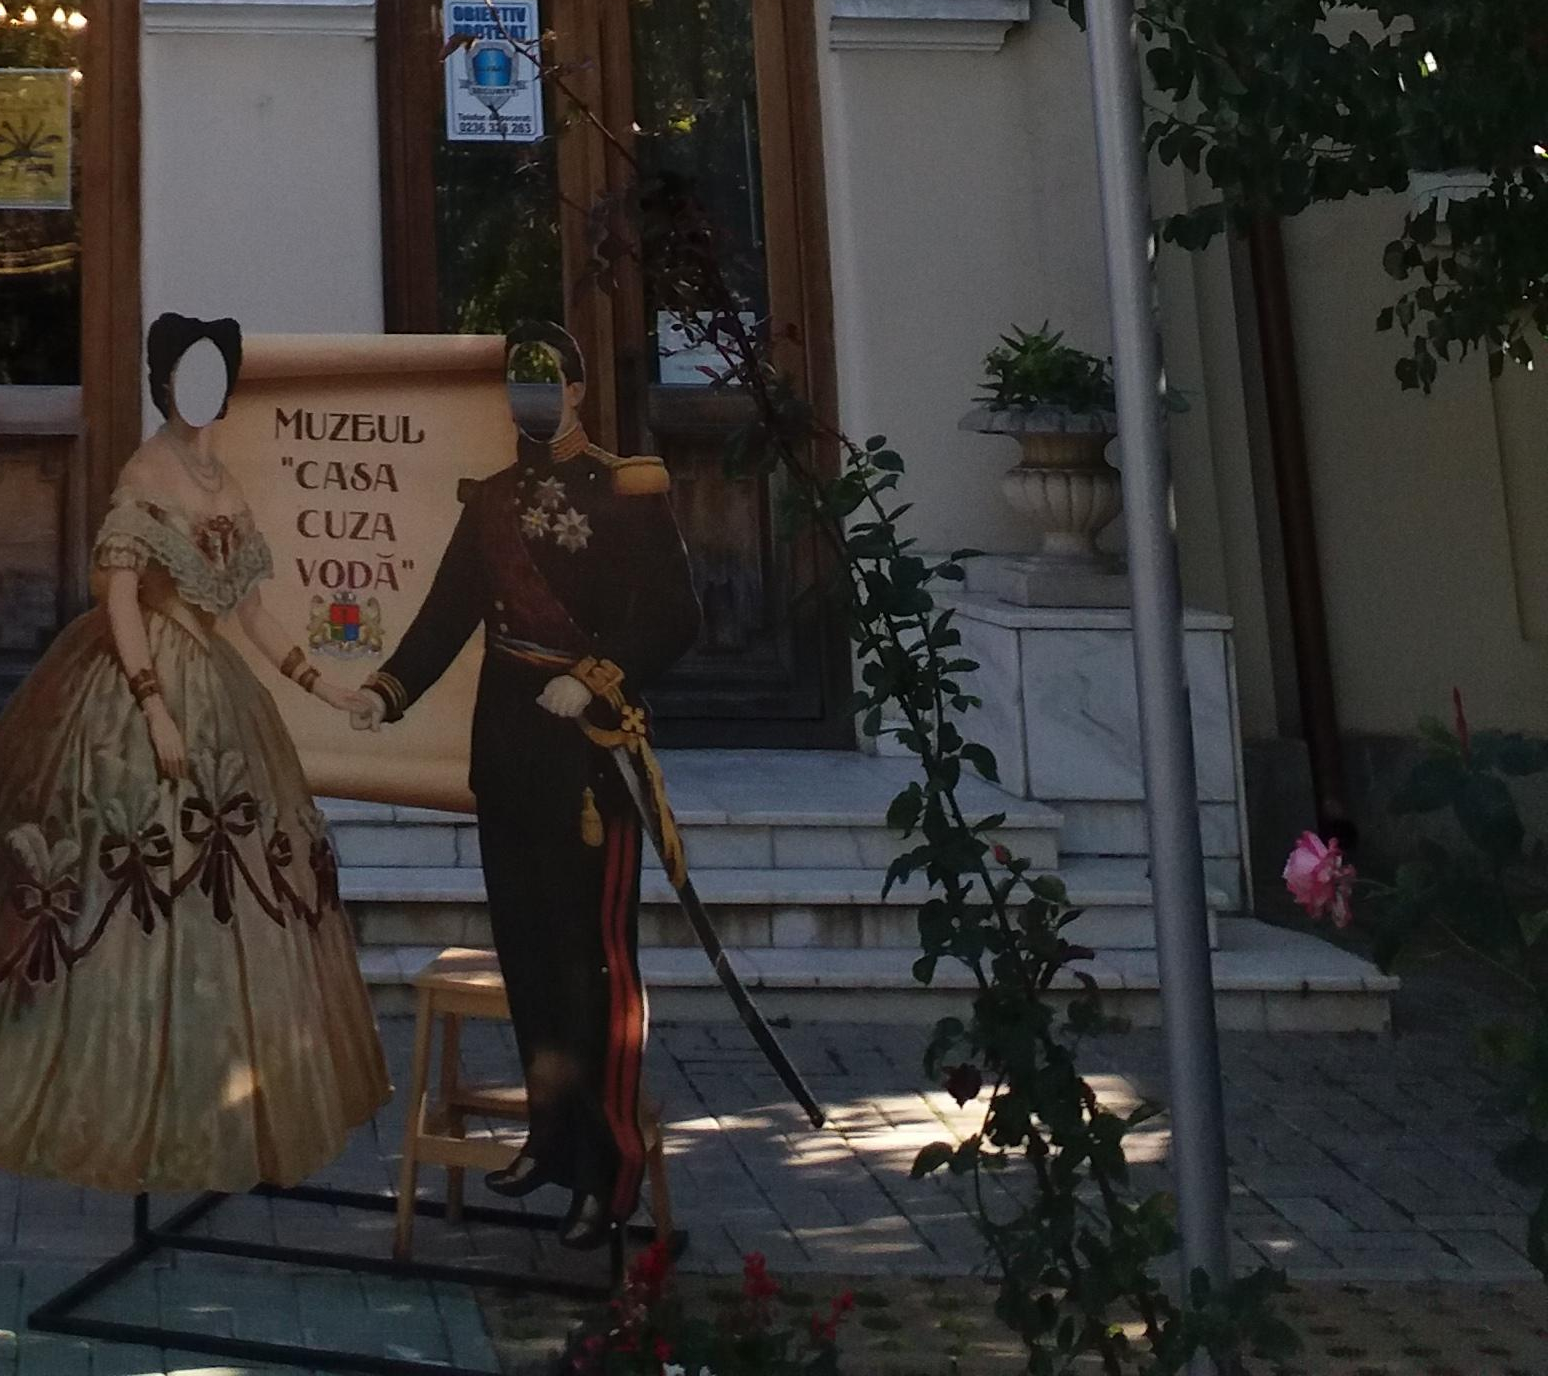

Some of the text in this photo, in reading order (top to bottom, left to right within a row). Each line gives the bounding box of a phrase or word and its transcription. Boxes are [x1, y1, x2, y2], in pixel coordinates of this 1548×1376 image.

[275, 407, 425, 444] MUZEUL
[281, 456, 399, 493] "CASA
[297, 509, 397, 542] CUZA
[296, 552, 415, 592] VODĂ"
